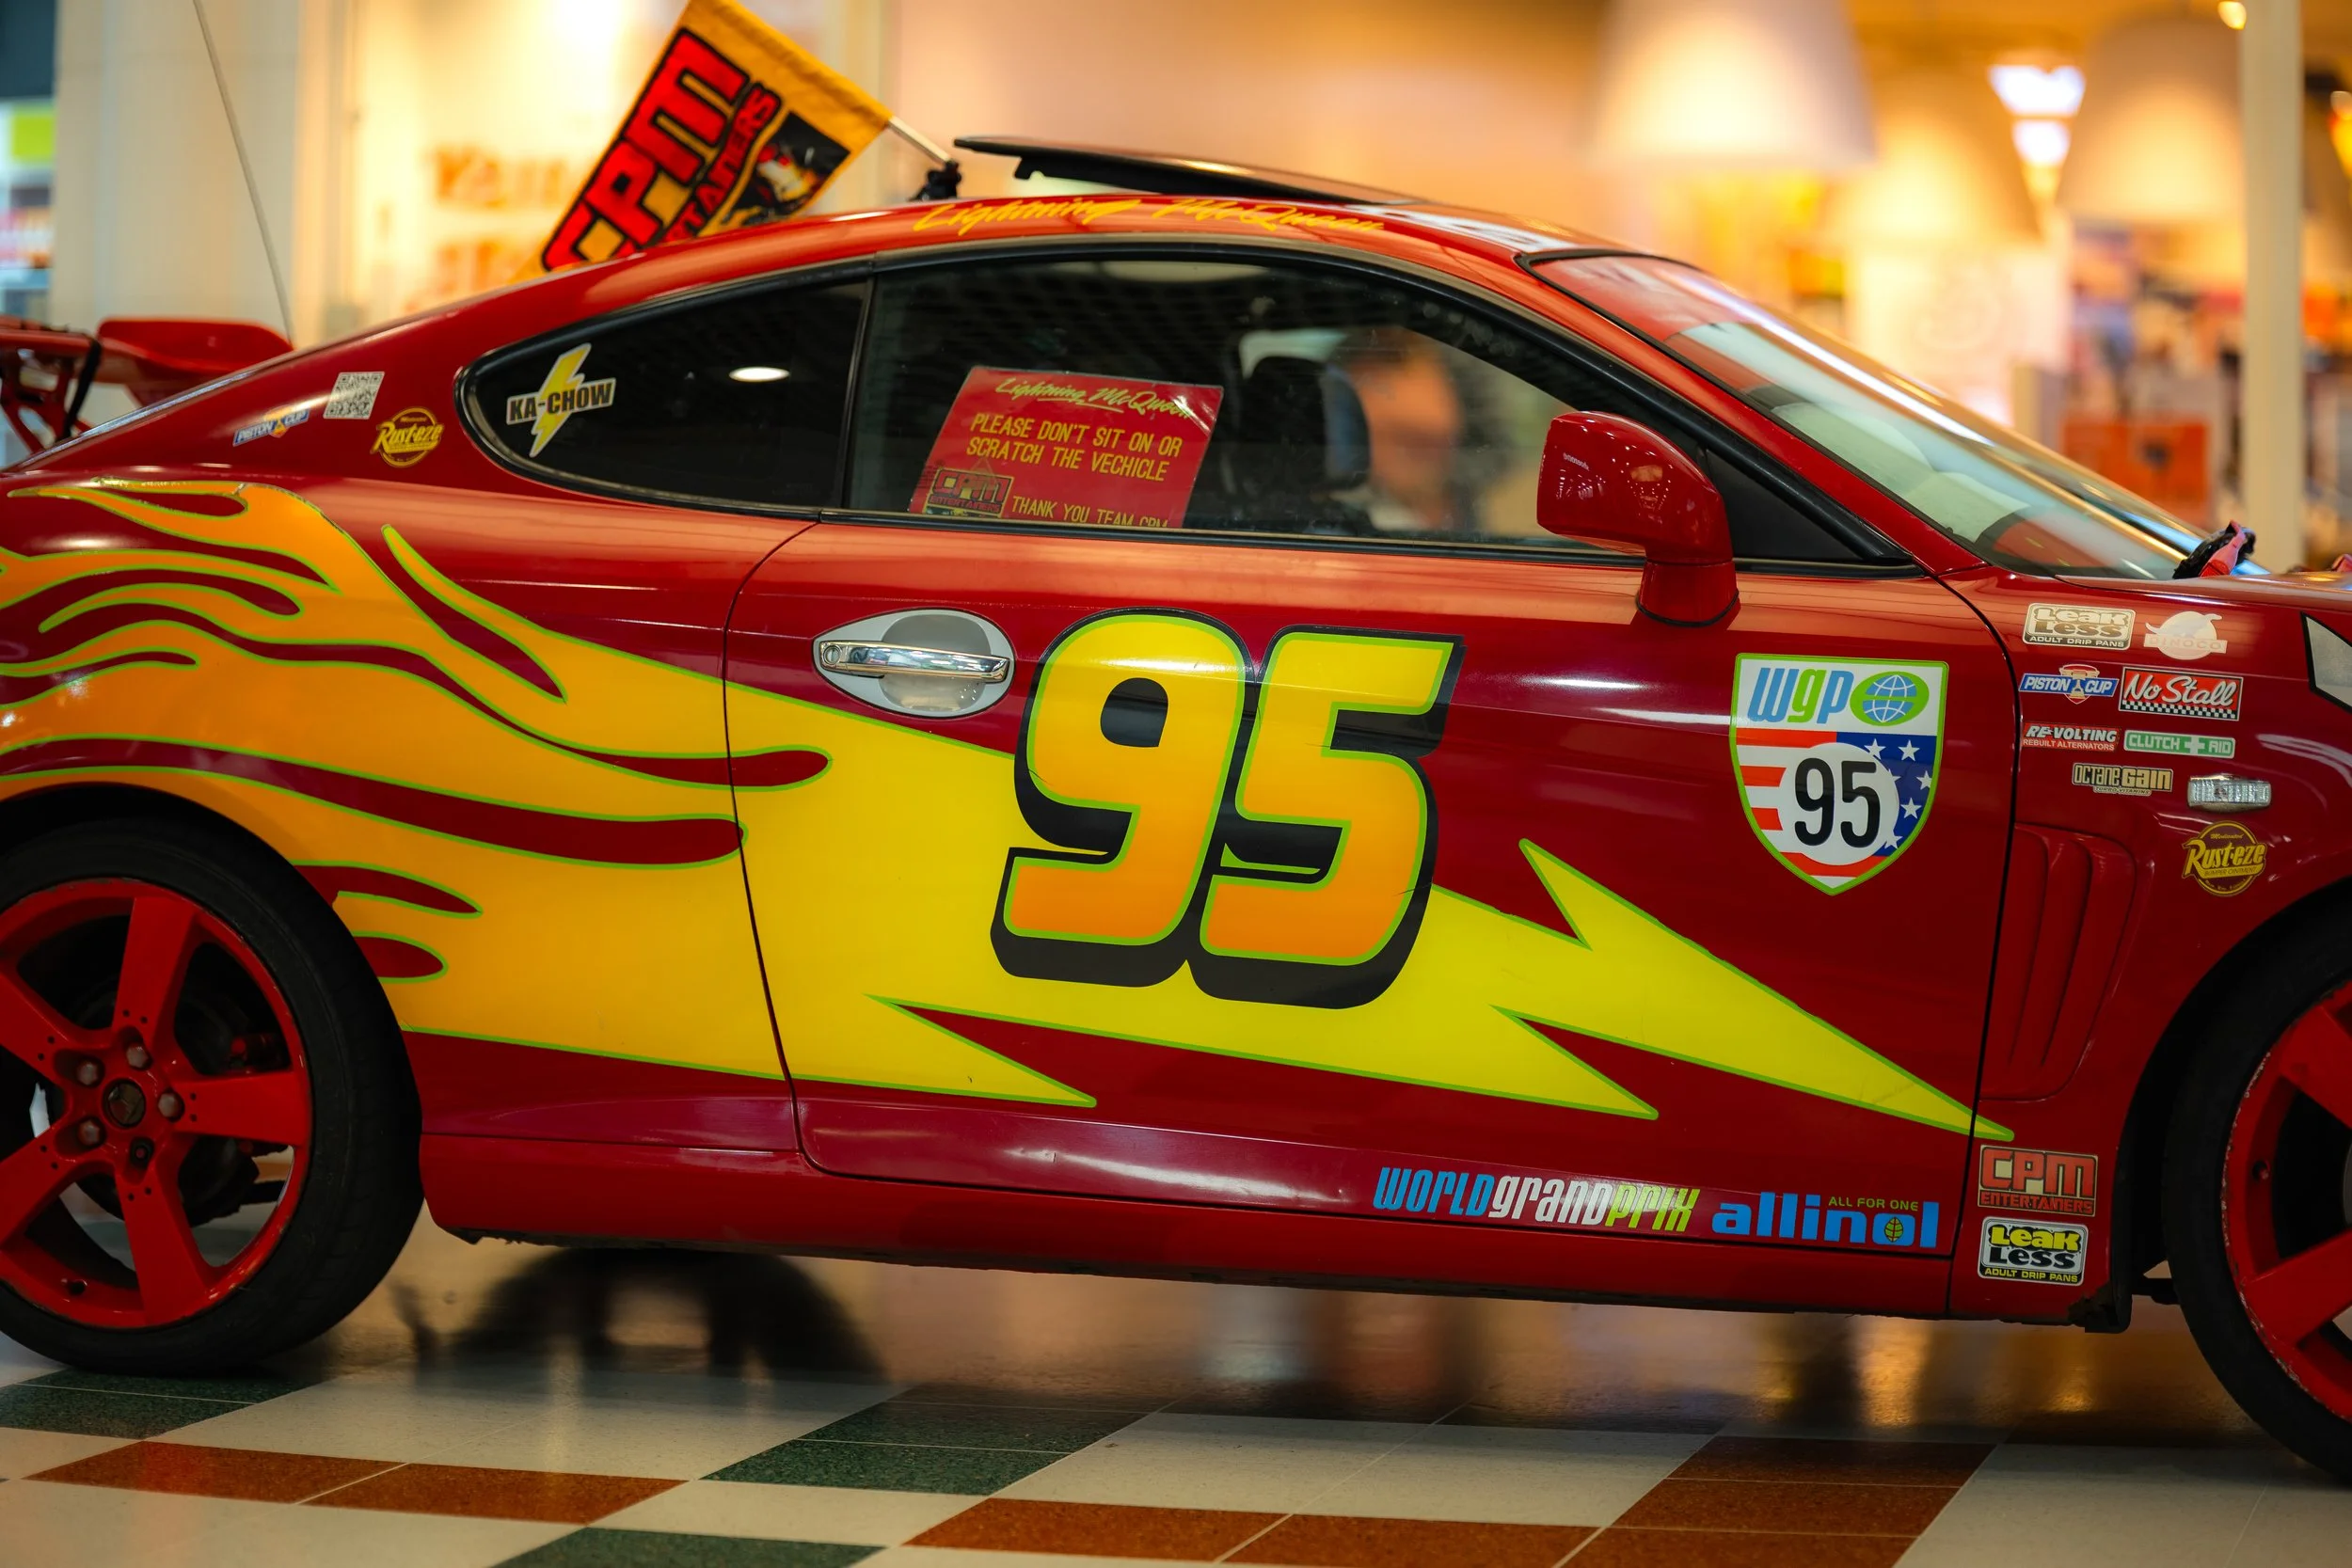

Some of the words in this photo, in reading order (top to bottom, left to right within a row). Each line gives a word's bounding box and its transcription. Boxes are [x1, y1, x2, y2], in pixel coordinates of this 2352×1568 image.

[542, 26, 749, 271] CPM
[913, 198, 1141, 235] Lightning
[509, 383, 613, 421] KA-CHOW
[995, 377, 1087, 402] Lightning
[970, 412, 1034, 438] PLEASE
[1037, 421, 1089, 444] DON'T
[1092, 427, 1125, 449] SIT
[1129, 432, 1153, 452] ON
[1158, 436, 1183, 457] OR
[966, 437, 1044, 465] SCRATCH
[1053, 447, 1084, 469] THE
[1090, 452, 1169, 482] VECHICLE
[933, 470, 1010, 502] CPM
[1012, 496, 1057, 518] THANK
[1064, 503, 1091, 523] YOU
[1097, 509, 1135, 526] TEAM
[2029, 636, 2063, 644] ADULT
[2095, 639, 2125, 648] PANS
[2024, 676, 2071, 692] PISTON
[2084, 680, 2113, 694] CUP
[2123, 673, 2162, 700] No
[2162, 675, 2237, 706] Stall
[2023, 738, 2056, 748] REBUILT
[2057, 740, 2115, 752] ALTERNATORS
[2026, 725, 2118, 743] RE-VOLTING
[2128, 734, 2181, 750] CLUTCH
[2208, 740, 2232, 755] AID
[993, 609, 1464, 997] 95
[1794, 757, 1881, 848] 95
[1980, 1146, 2096, 1197] CPM
[1712, 1192, 1940, 1248] allinol
[1828, 1196, 1853, 1208] ALL
[1857, 1197, 1885, 1209] FOR
[1890, 1199, 1919, 1212] ONE
[1984, 1268, 2017, 1278] ADULT
[2021, 1270, 2046, 1280] DRIP
[2049, 1273, 2078, 1283] PANS
